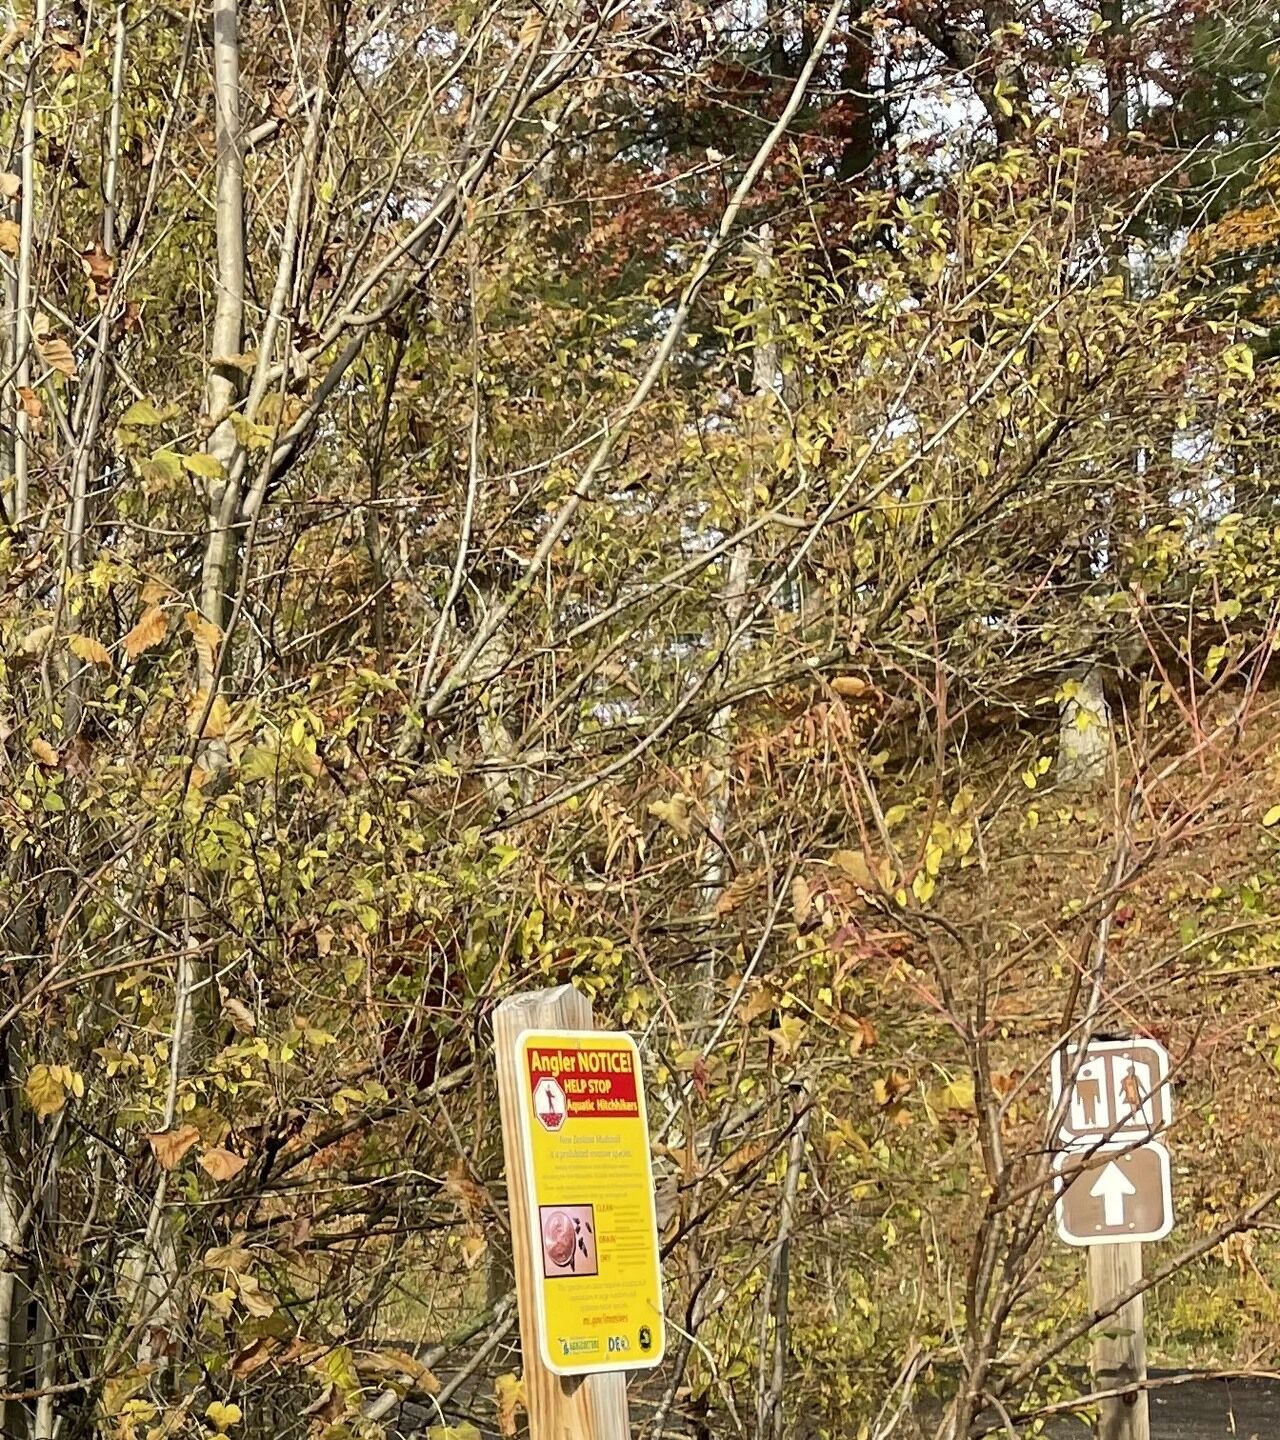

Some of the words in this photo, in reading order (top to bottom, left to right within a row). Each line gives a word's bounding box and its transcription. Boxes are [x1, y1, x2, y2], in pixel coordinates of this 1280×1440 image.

[532, 1050, 576, 1077] Angler
[577, 1051, 632, 1073] NOTICE!
[564, 1079, 587, 1094] HELP
[588, 1079, 612, 1094] STOP
[567, 1098, 595, 1114] Aquatic
[597, 1098, 638, 1112] Hitchhikers
